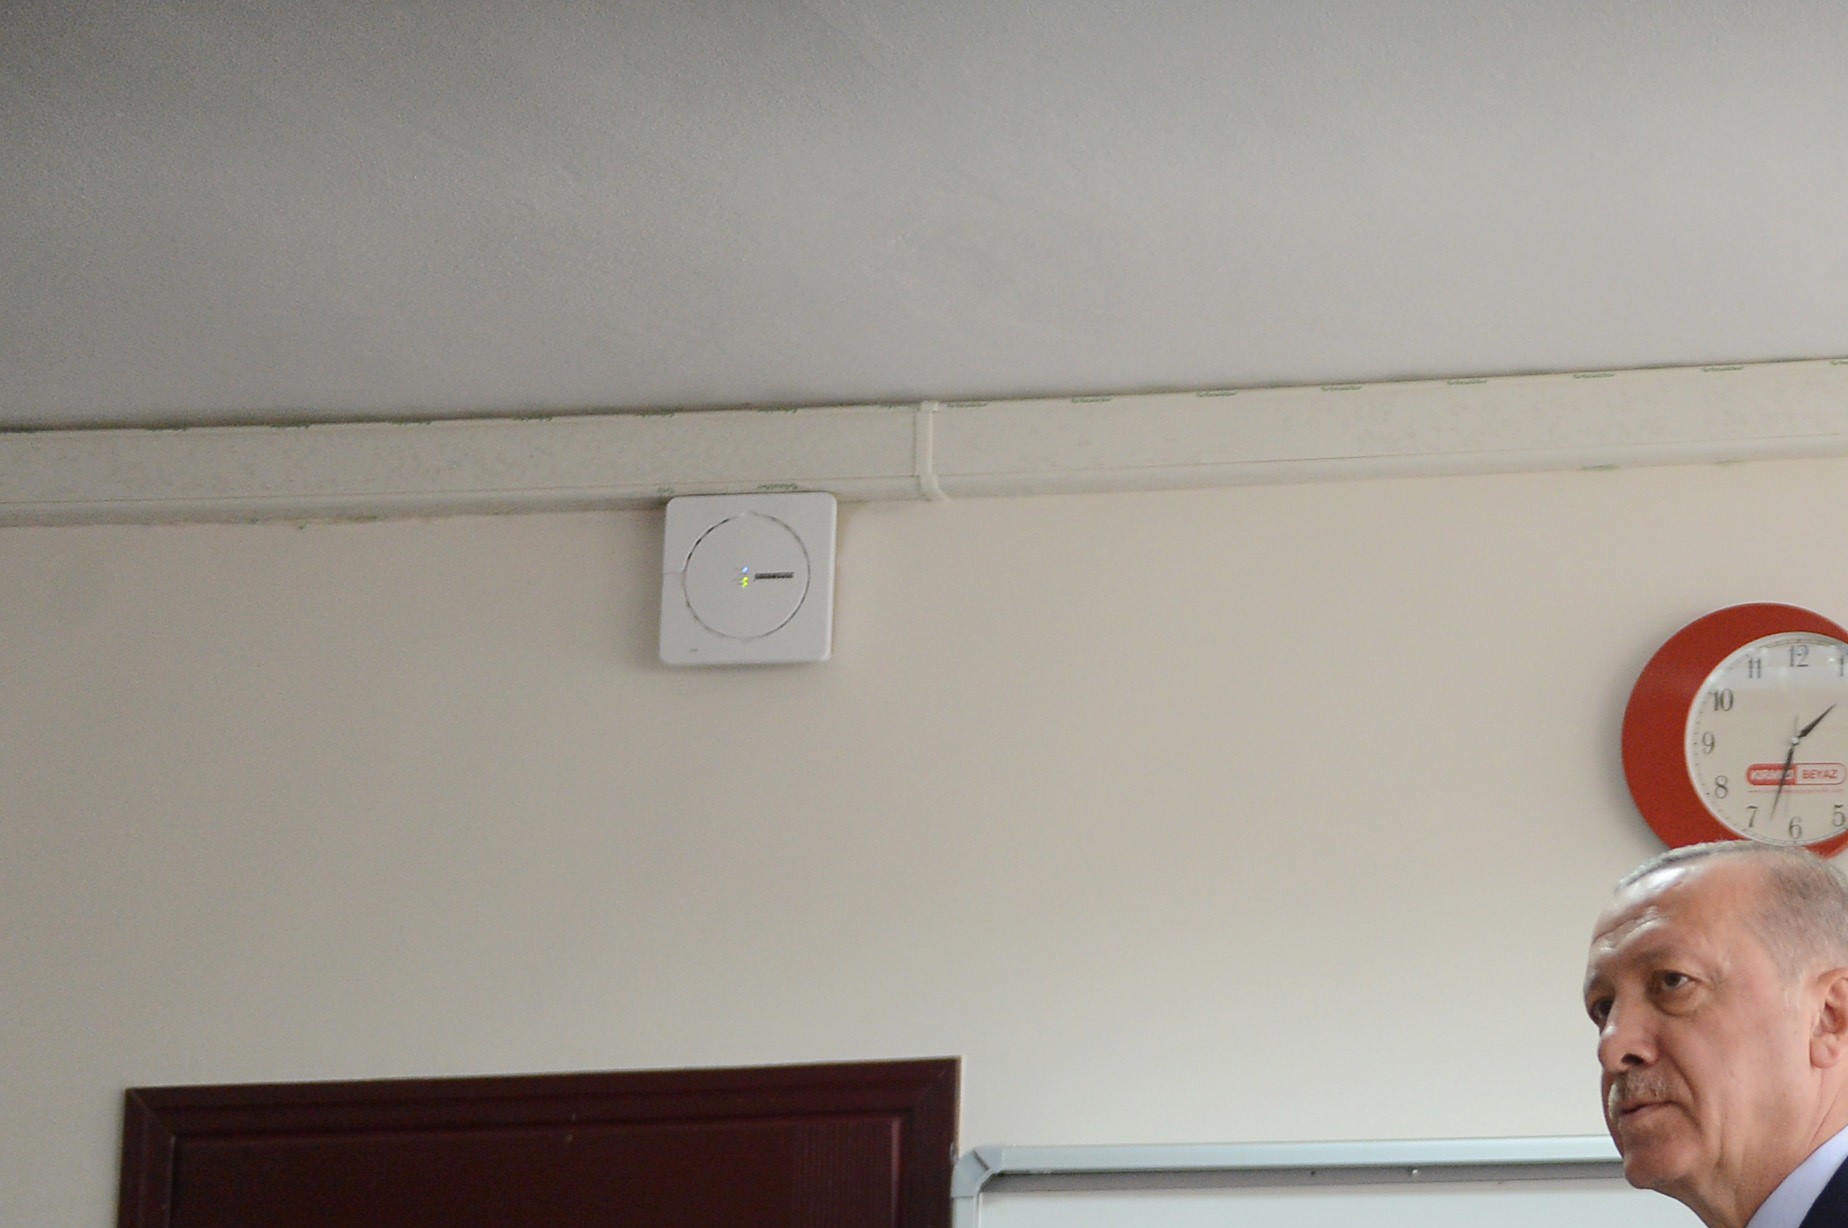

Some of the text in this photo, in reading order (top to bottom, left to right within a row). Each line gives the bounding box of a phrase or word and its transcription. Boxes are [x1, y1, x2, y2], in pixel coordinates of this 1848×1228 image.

[1748, 656, 1761, 679] 11
[1790, 644, 1809, 668] 12
[1838, 654, 1845, 677] 1
[1711, 688, 1734, 712] 10
[1702, 731, 1715, 755] 9
[1802, 769, 1838, 779] BEYAZ
[1714, 774, 1728, 799] 8
[1746, 805, 1758, 828] 7
[1832, 804, 1846, 827] 5
[1788, 816, 1802, 840] 6
